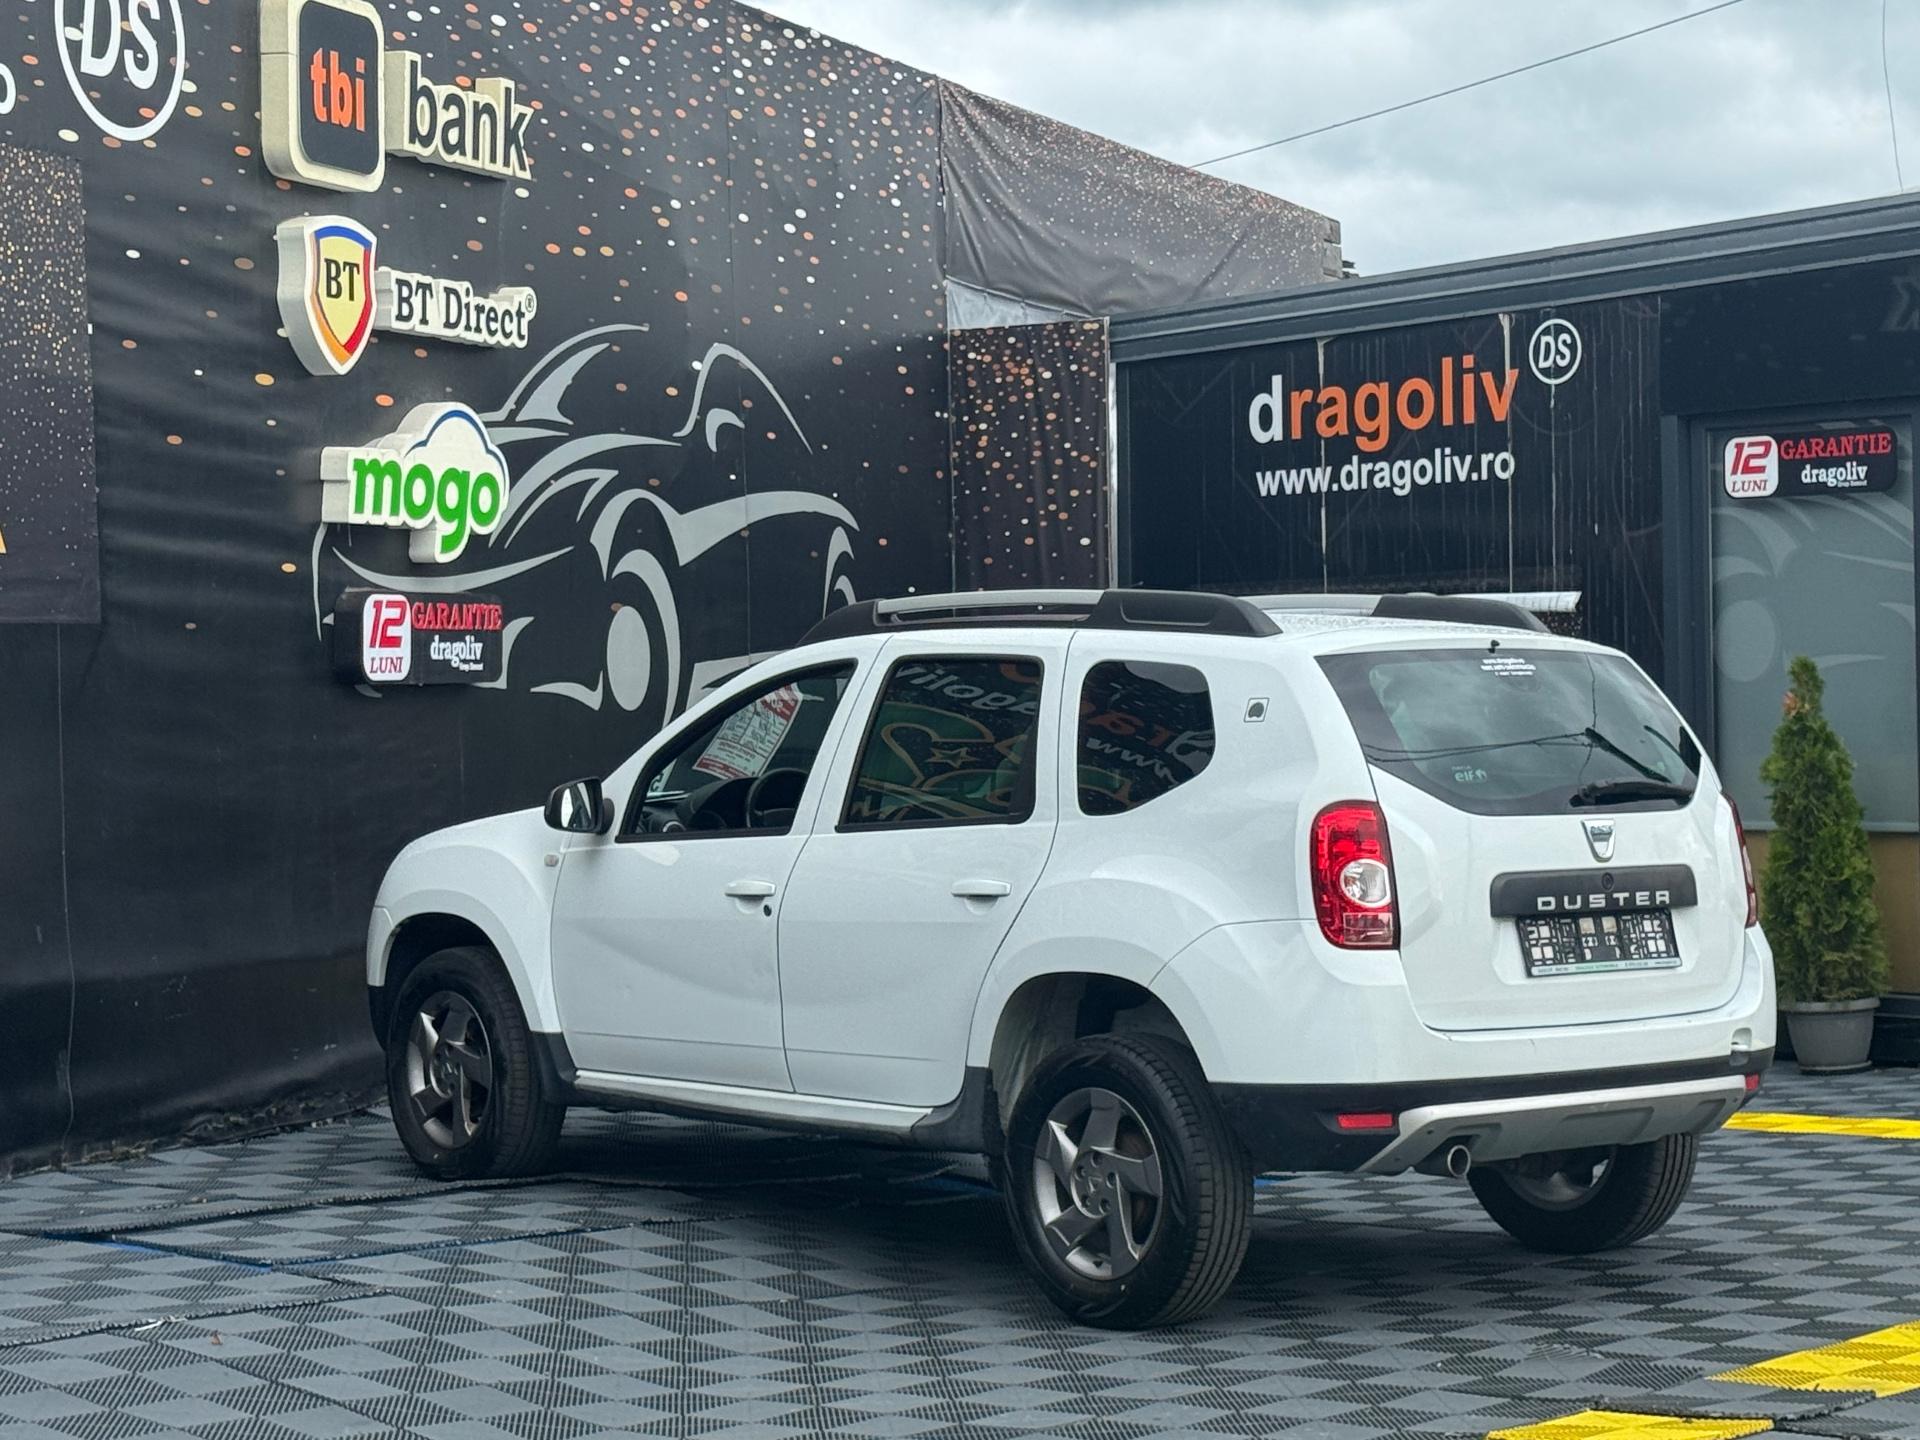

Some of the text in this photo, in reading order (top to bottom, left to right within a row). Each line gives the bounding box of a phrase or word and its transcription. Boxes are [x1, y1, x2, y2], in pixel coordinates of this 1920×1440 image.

[80, 0, 160, 90] DS
[311, 48, 527, 172] tbi bank
[324, 258, 360, 301] BT
[395, 278, 433, 326] BT
[1538, 332, 1573, 370] DS
[1248, 354, 1519, 452] dragoliv
[1730, 440, 1772, 476] 12
[1780, 433, 1892, 461] GARANTIE
[1256, 447, 1516, 497] www.dragoliv.ro
[1731, 479, 1769, 493] LUNI
[1801, 461, 1868, 487] dragoliv
[353, 458, 501, 555] mogo
[369, 600, 407, 649] 12
[411, 602, 503, 631] GARANTIE
[370, 656, 404, 675] LUNI
[430, 635, 483, 668] dragoliv
[1537, 889, 1671, 912] DUSTER
